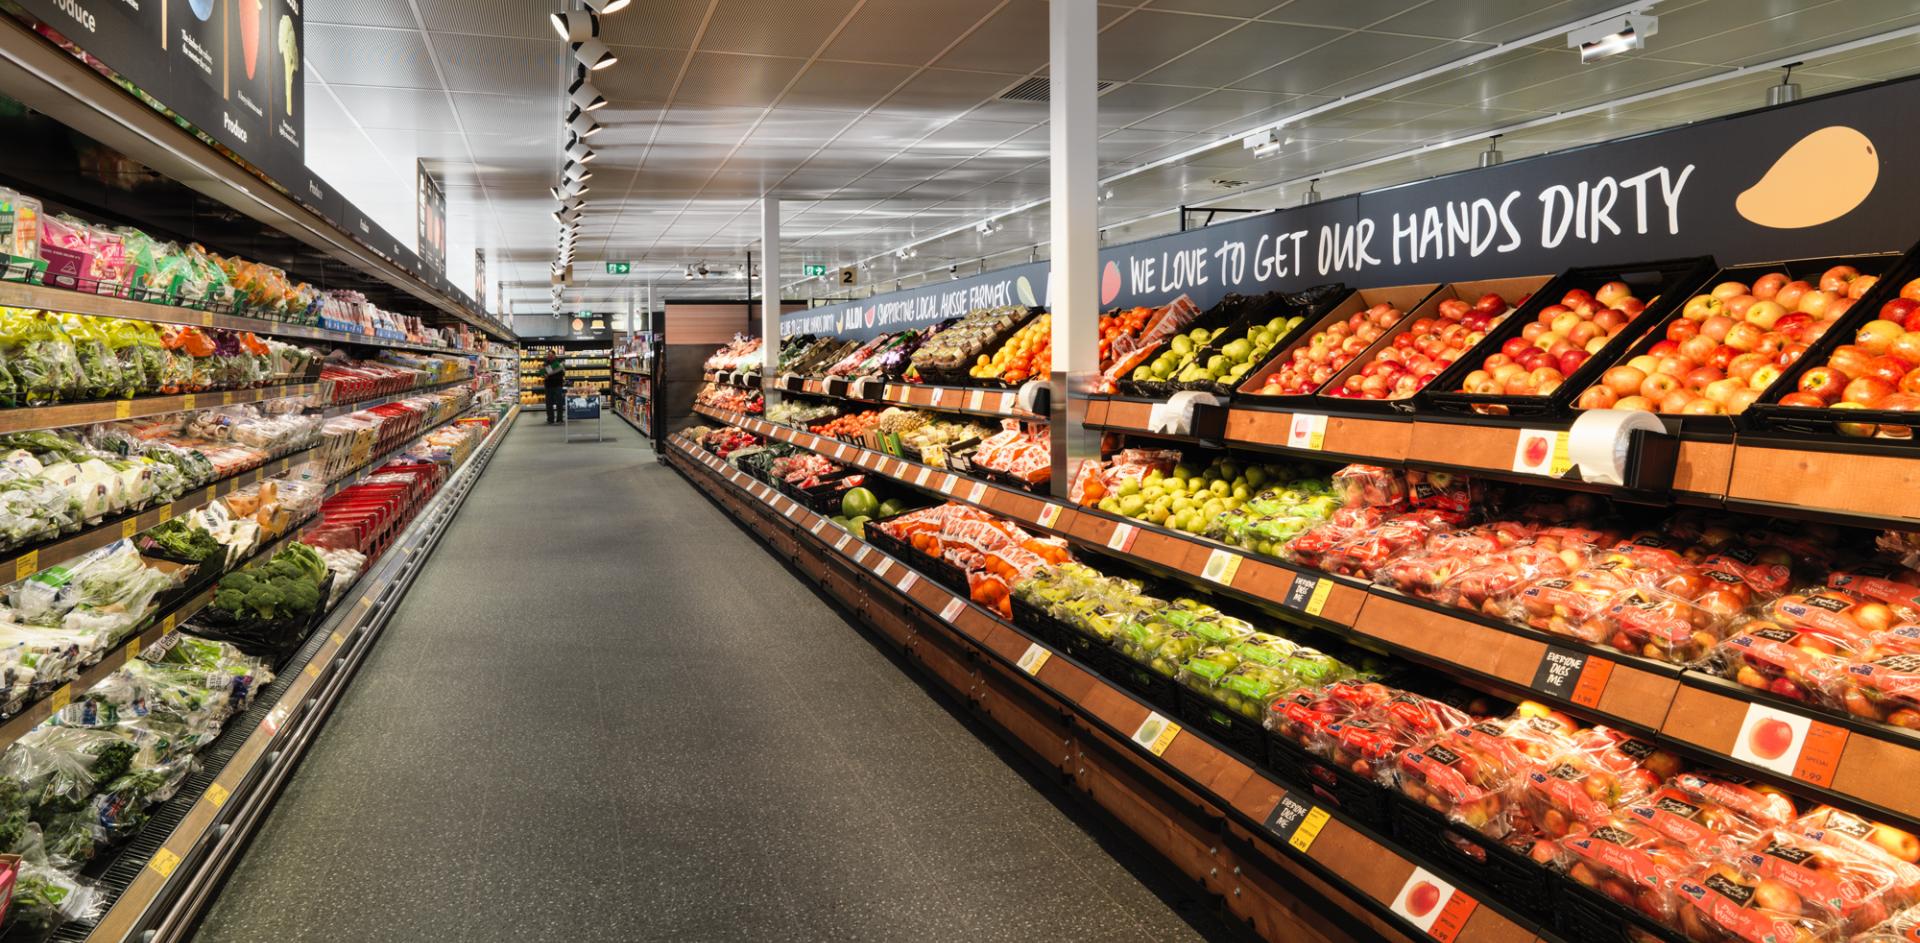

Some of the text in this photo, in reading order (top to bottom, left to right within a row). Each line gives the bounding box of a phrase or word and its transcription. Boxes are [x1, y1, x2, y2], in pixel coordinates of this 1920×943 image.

[223, 111, 247, 143] Produce
[1130, 163, 1696, 295] WE LOVE TO GET OUR HANDS DIRTY
[843, 271, 853, 283] 2
[877, 297, 915, 326] SUPPORTING
[915, 294, 939, 320] LOCAL
[940, 289, 968, 318] AUSSIE
[969, 280, 1012, 310] FARMERS
[845, 306, 862, 330] ALDI
[1546, 651, 1583, 669] EVERYONE
[1549, 662, 1571, 677] DIGS
[1546, 674, 1564, 687] ME
[1280, 807, 1298, 821] DIGS
[1281, 797, 1308, 817] EVERYONE
[1275, 816, 1290, 829] ME
